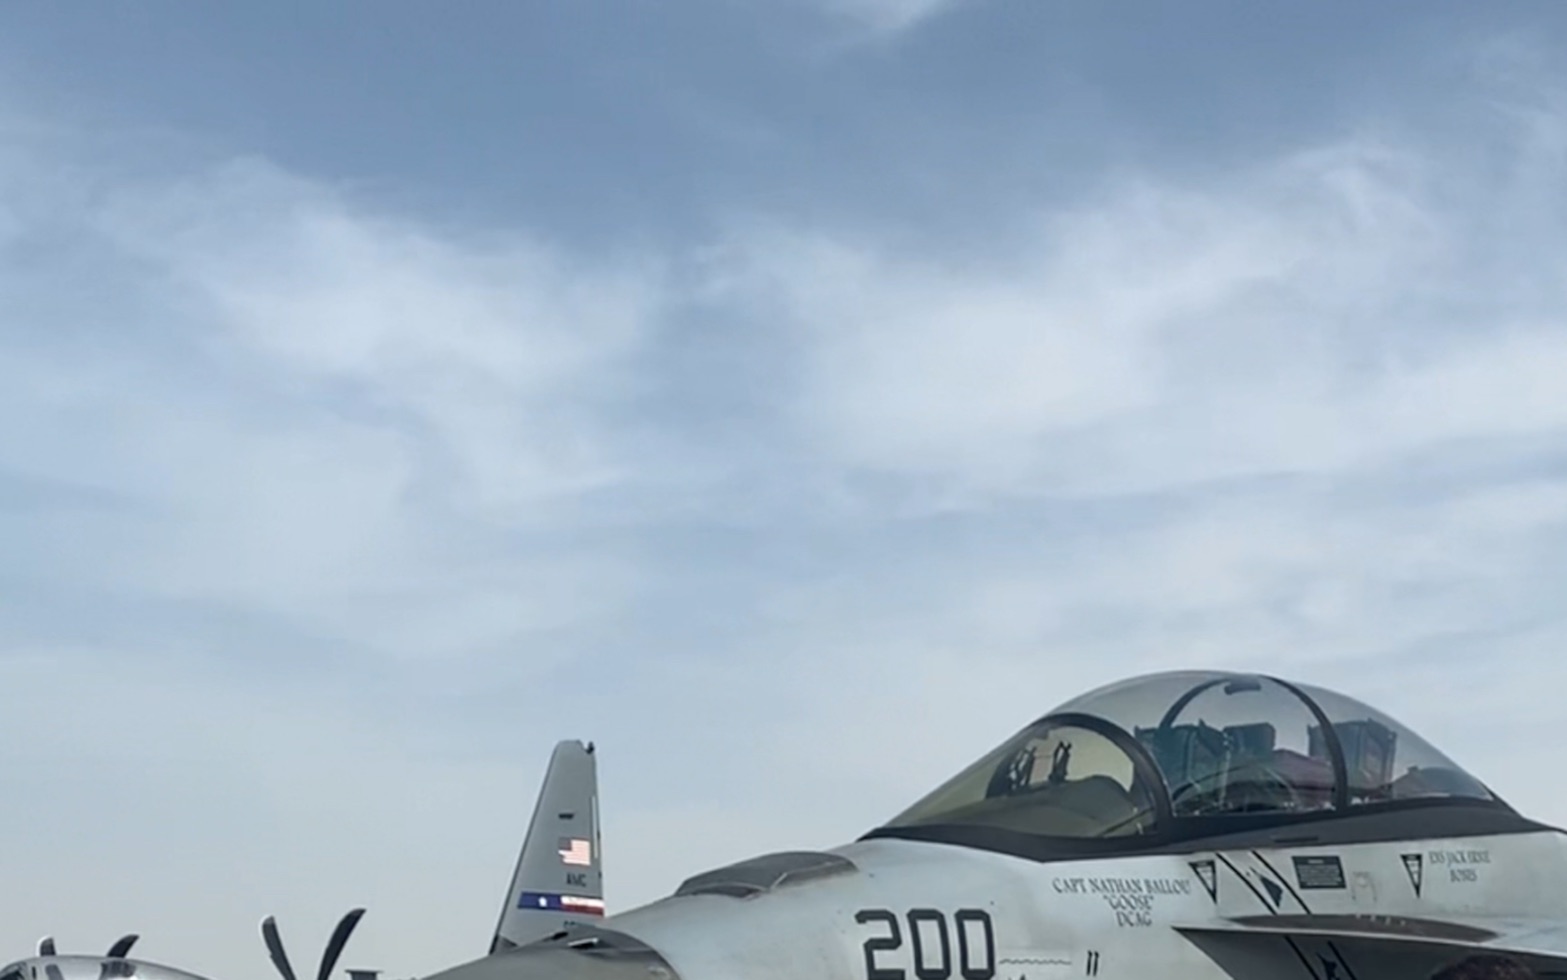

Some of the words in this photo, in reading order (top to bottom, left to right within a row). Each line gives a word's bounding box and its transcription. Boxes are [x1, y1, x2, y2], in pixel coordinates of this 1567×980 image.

[1052, 878, 1088, 894] CAPT
[1088, 878, 1142, 894] NATHAN
[1143, 878, 1191, 895] BALLOU
[1116, 911, 1152, 927] DCAG
